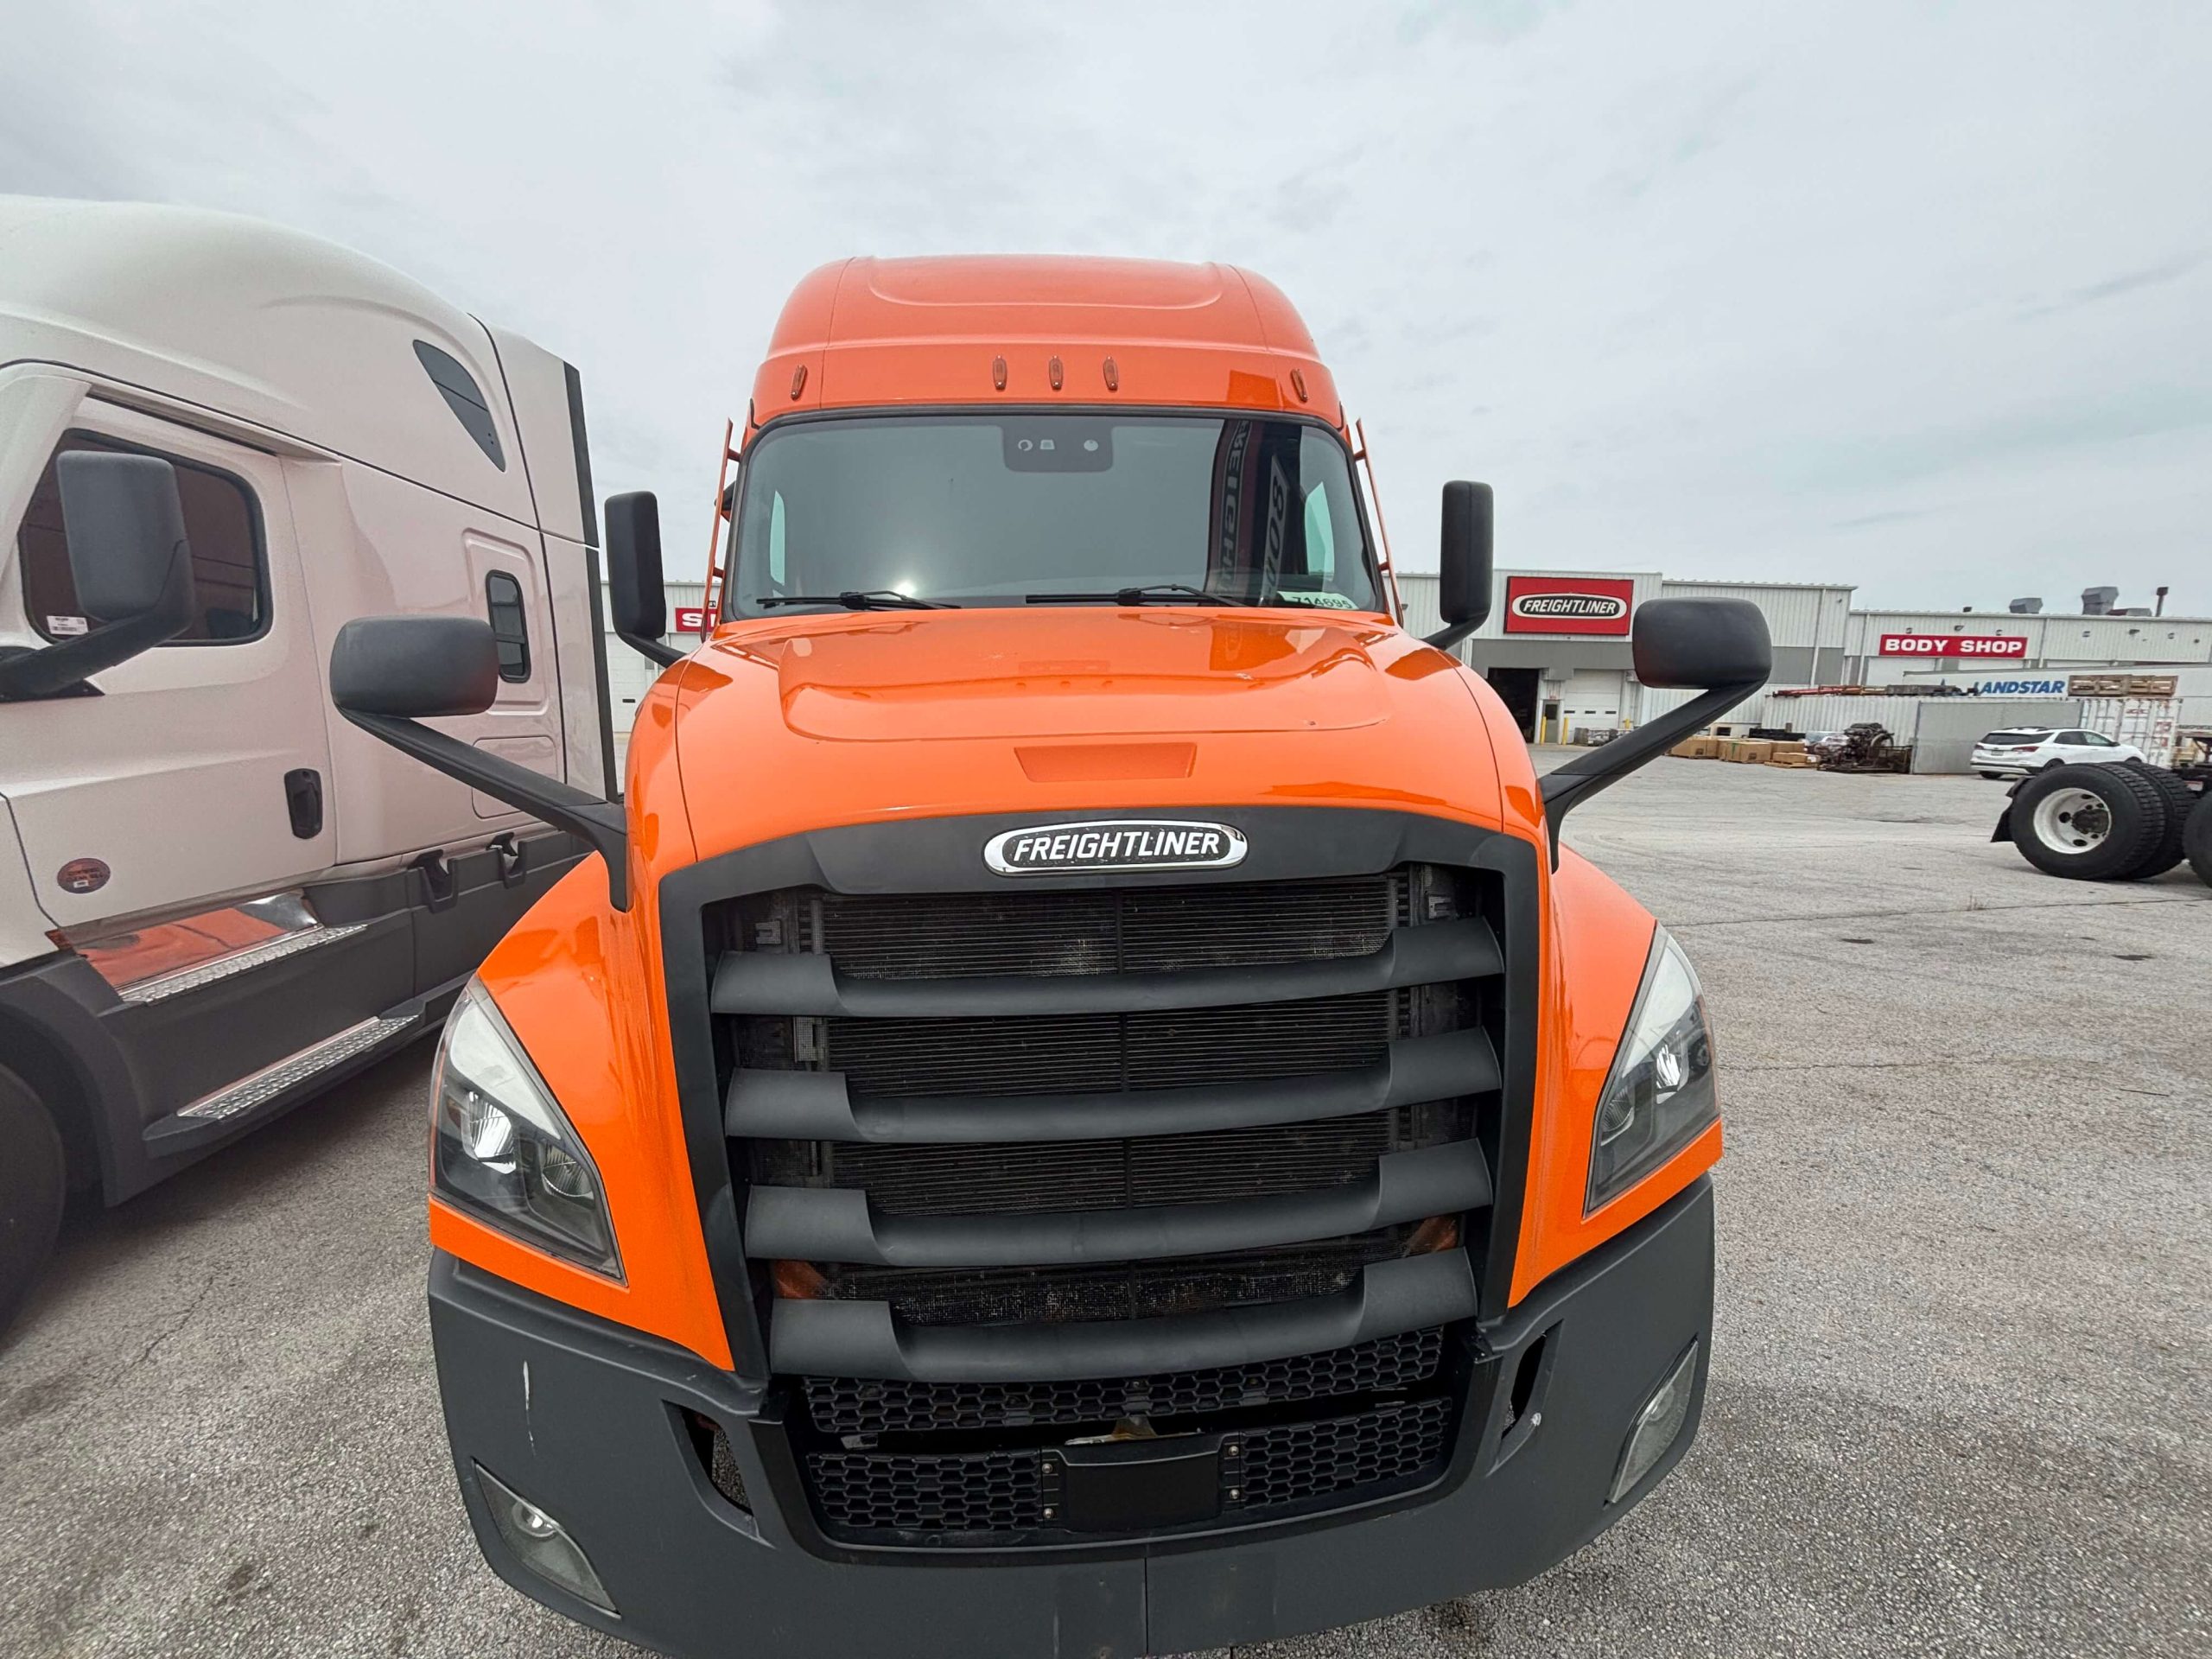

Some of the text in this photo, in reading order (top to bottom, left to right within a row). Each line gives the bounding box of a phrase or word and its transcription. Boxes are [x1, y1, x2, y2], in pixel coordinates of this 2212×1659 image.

[1522, 598, 1617, 614] FREIGHTLINER
[1885, 638, 2023, 653] BODY SHOP
[1013, 830, 1220, 861] FREIGHTLINER
